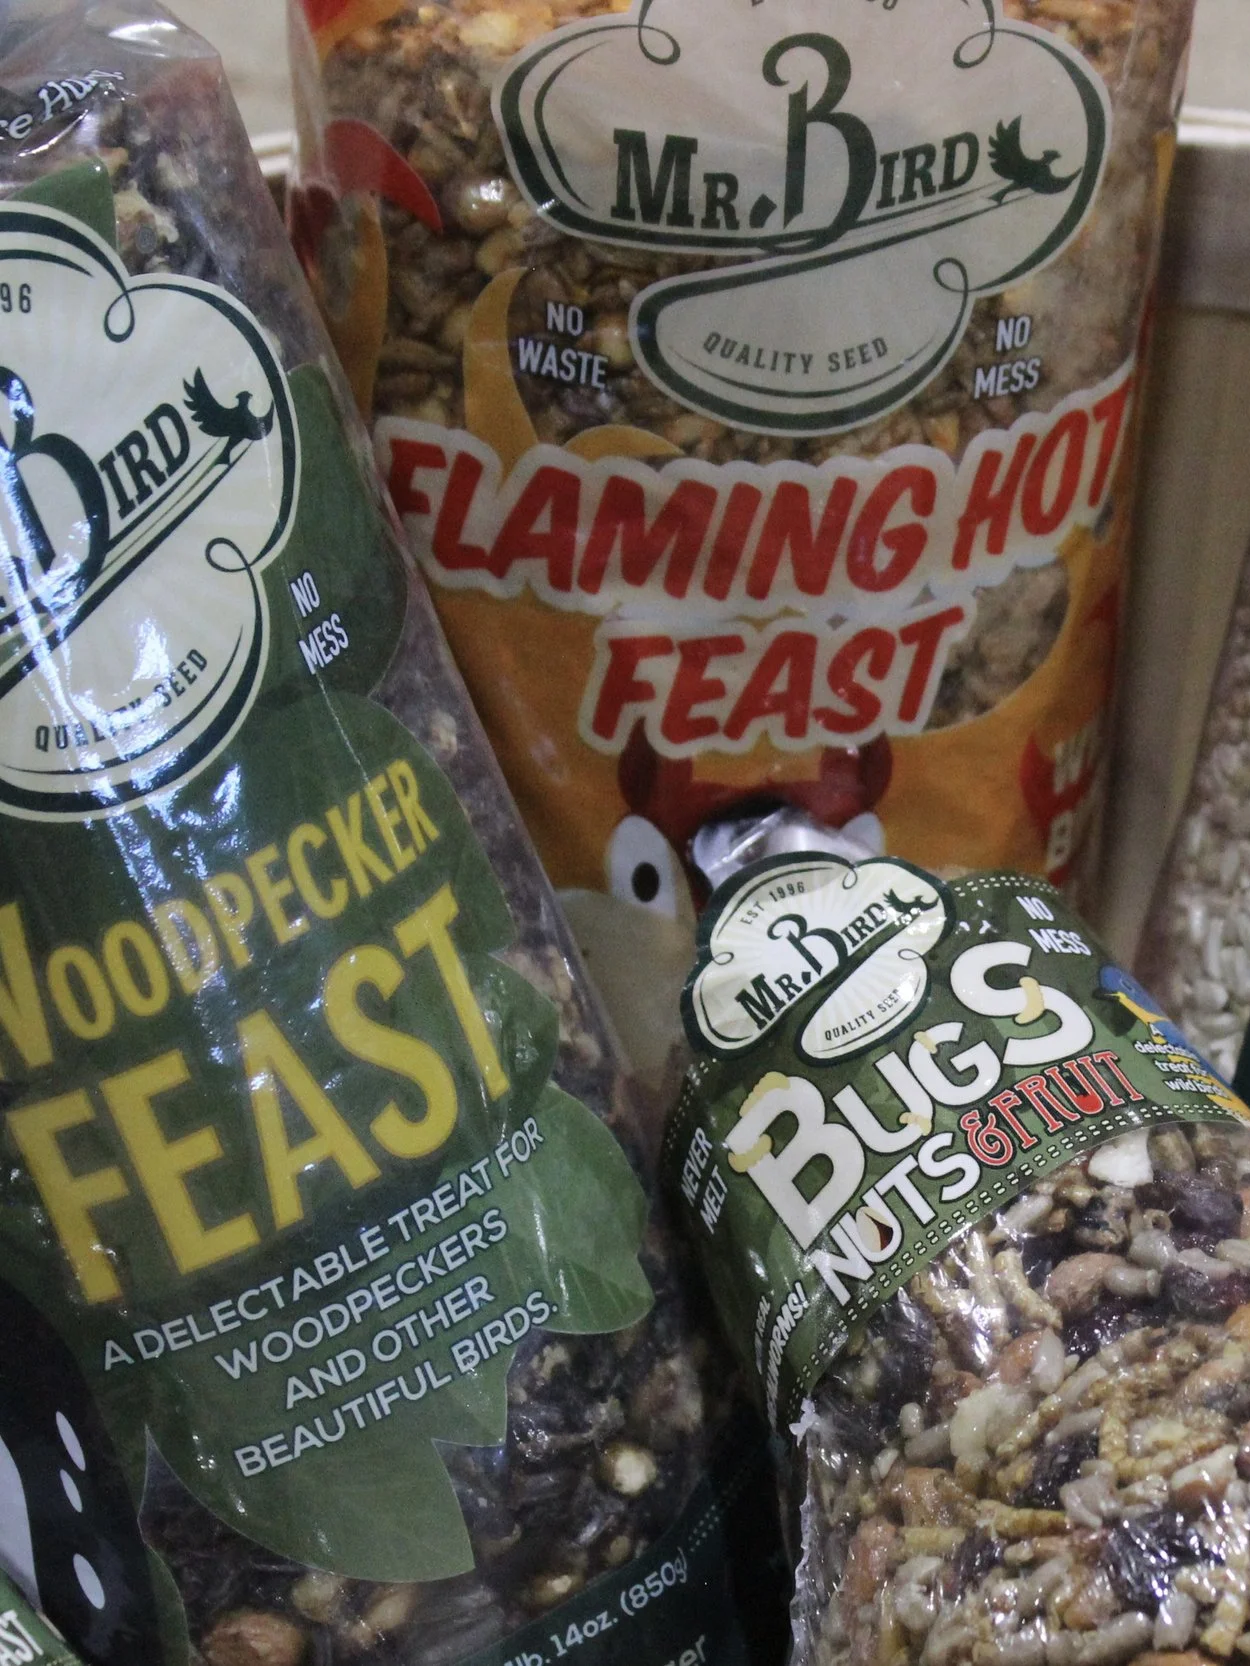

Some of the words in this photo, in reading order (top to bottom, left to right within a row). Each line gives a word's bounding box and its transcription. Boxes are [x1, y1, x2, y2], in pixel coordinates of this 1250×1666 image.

[762, 32, 980, 250] BIRD
[546, 301, 584, 337] NO
[703, 330, 814, 374] QUALITY
[827, 336, 889, 373] SEED
[995, 314, 1032, 351] NO
[517, 337, 609, 388] WASTE
[973, 358, 1042, 399] MESS
[388, 437, 938, 600] FLAMING
[950, 372, 1135, 571] HOT
[289, 570, 321, 619] NO
[298, 613, 349, 675] MESS
[593, 604, 964, 748] FEAST
[740, 899, 768, 926] EST
[769, 879, 807, 903] 1996
[767, 901, 889, 976] BIRD
[1016, 896, 1053, 923] NO
[1030, 927, 1091, 958] MESS
[824, 1009, 877, 1042] QUALITY
[5, 881, 511, 1304] FEAST
[727, 941, 1095, 1251] BUGS
[1165, 1079, 1198, 1092] wild
[681, 1127, 712, 1207] NEVER
[700, 1164, 727, 1235] MELT
[102, 1339, 136, 1371] A
[135, 1227, 391, 1362] DELECTABLE
[388, 1158, 494, 1244] TREAT
[495, 1115, 545, 1179] FOR
[811, 1131, 981, 1306] NUTS
[214, 1208, 509, 1380] WOODPECKERS
[284, 1348, 366, 1410] AND
[373, 1274, 495, 1363] OTHER
[234, 1359, 452, 1478] BEAUTIFUL
[452, 1289, 559, 1376] BIRDS.
[551, 1610, 618, 1657] 14oz.
[620, 1546, 688, 1616] (850g)
